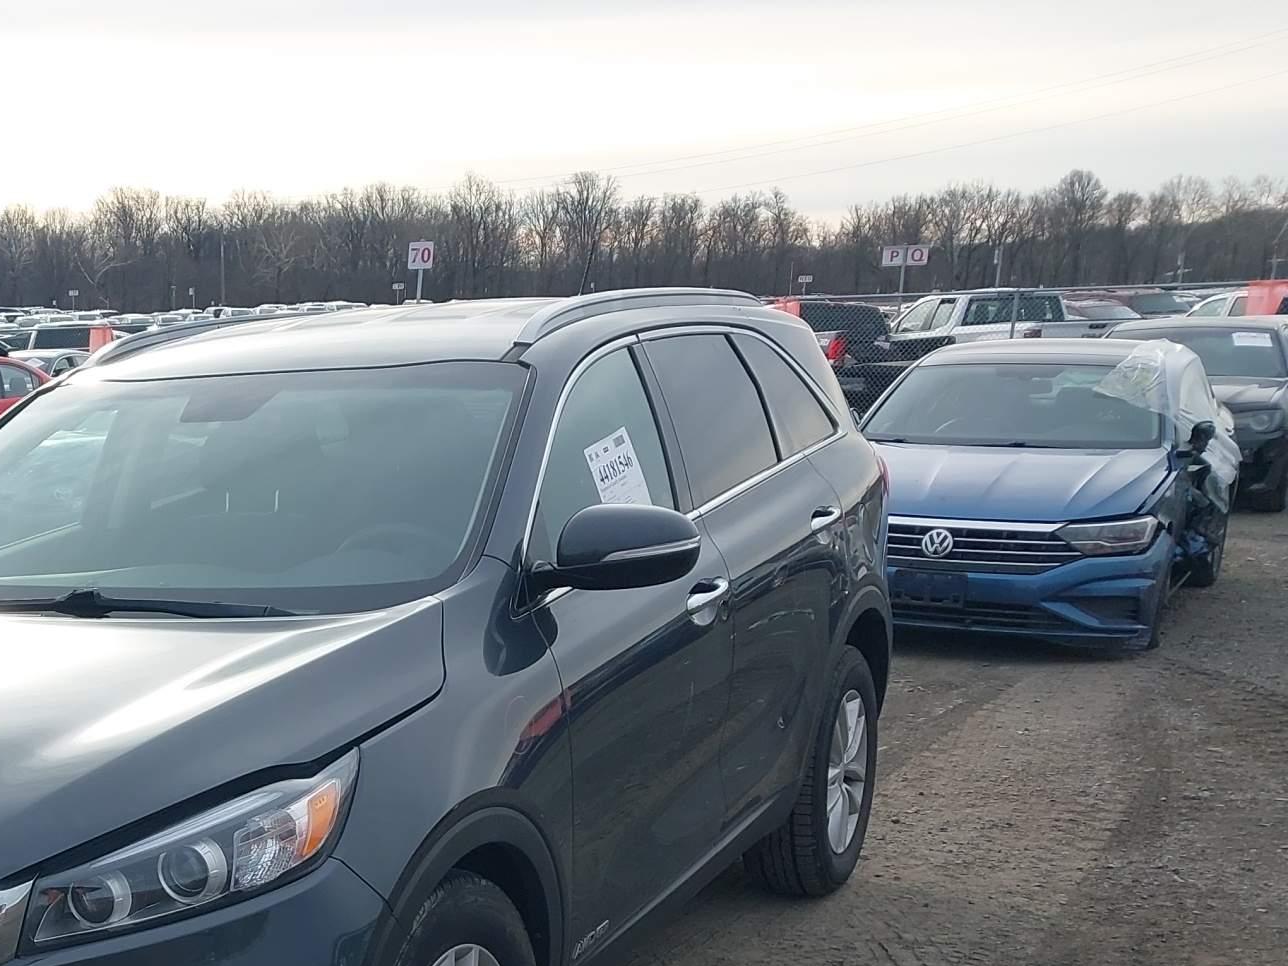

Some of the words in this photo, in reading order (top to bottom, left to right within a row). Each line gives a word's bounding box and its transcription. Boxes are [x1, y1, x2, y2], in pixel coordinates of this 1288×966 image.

[411, 247, 431, 263] 70
[889, 250, 899, 262] P
[911, 248, 925, 262] Q
[598, 449, 633, 485] 44181546
